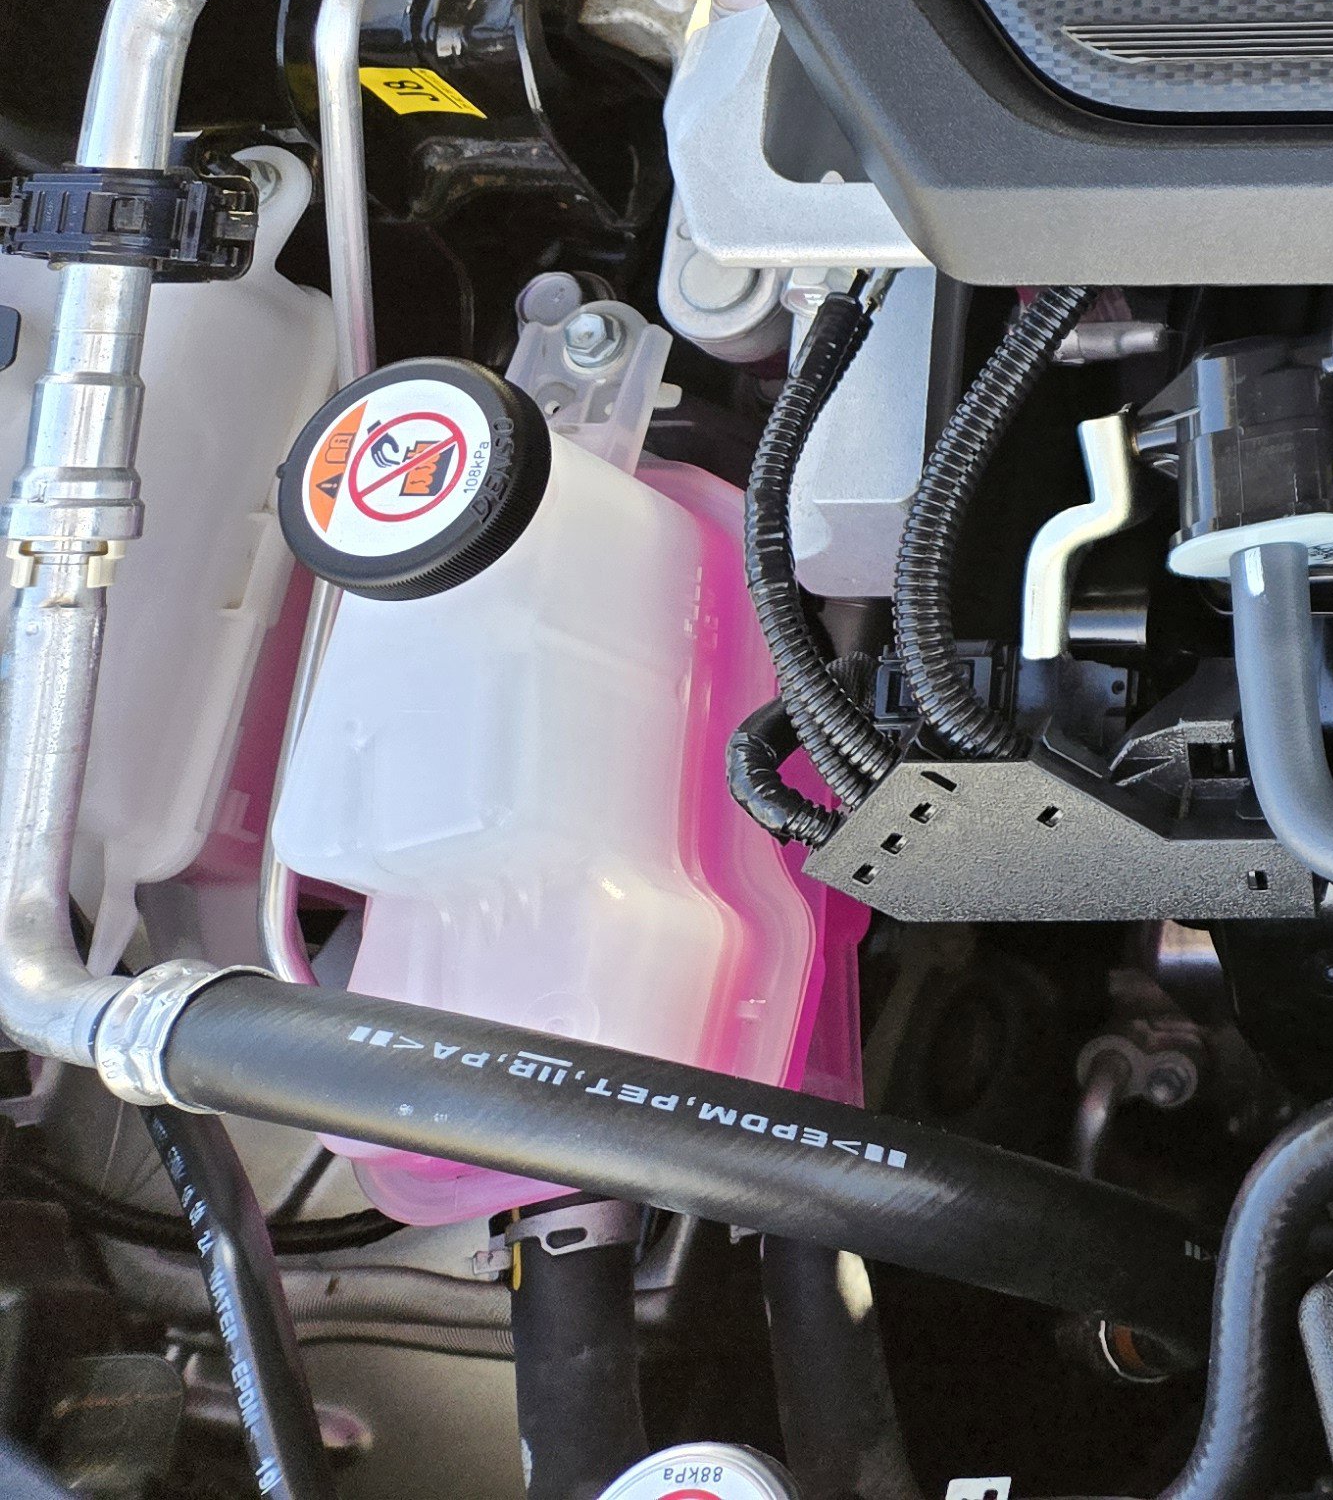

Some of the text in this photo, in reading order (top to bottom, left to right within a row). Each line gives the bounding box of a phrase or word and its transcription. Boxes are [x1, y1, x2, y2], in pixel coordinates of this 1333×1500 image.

[463, 440, 490, 494] 108kPa
[470, 416, 516, 526] DENSO
[662, 1466, 723, 1484] 88kPa
